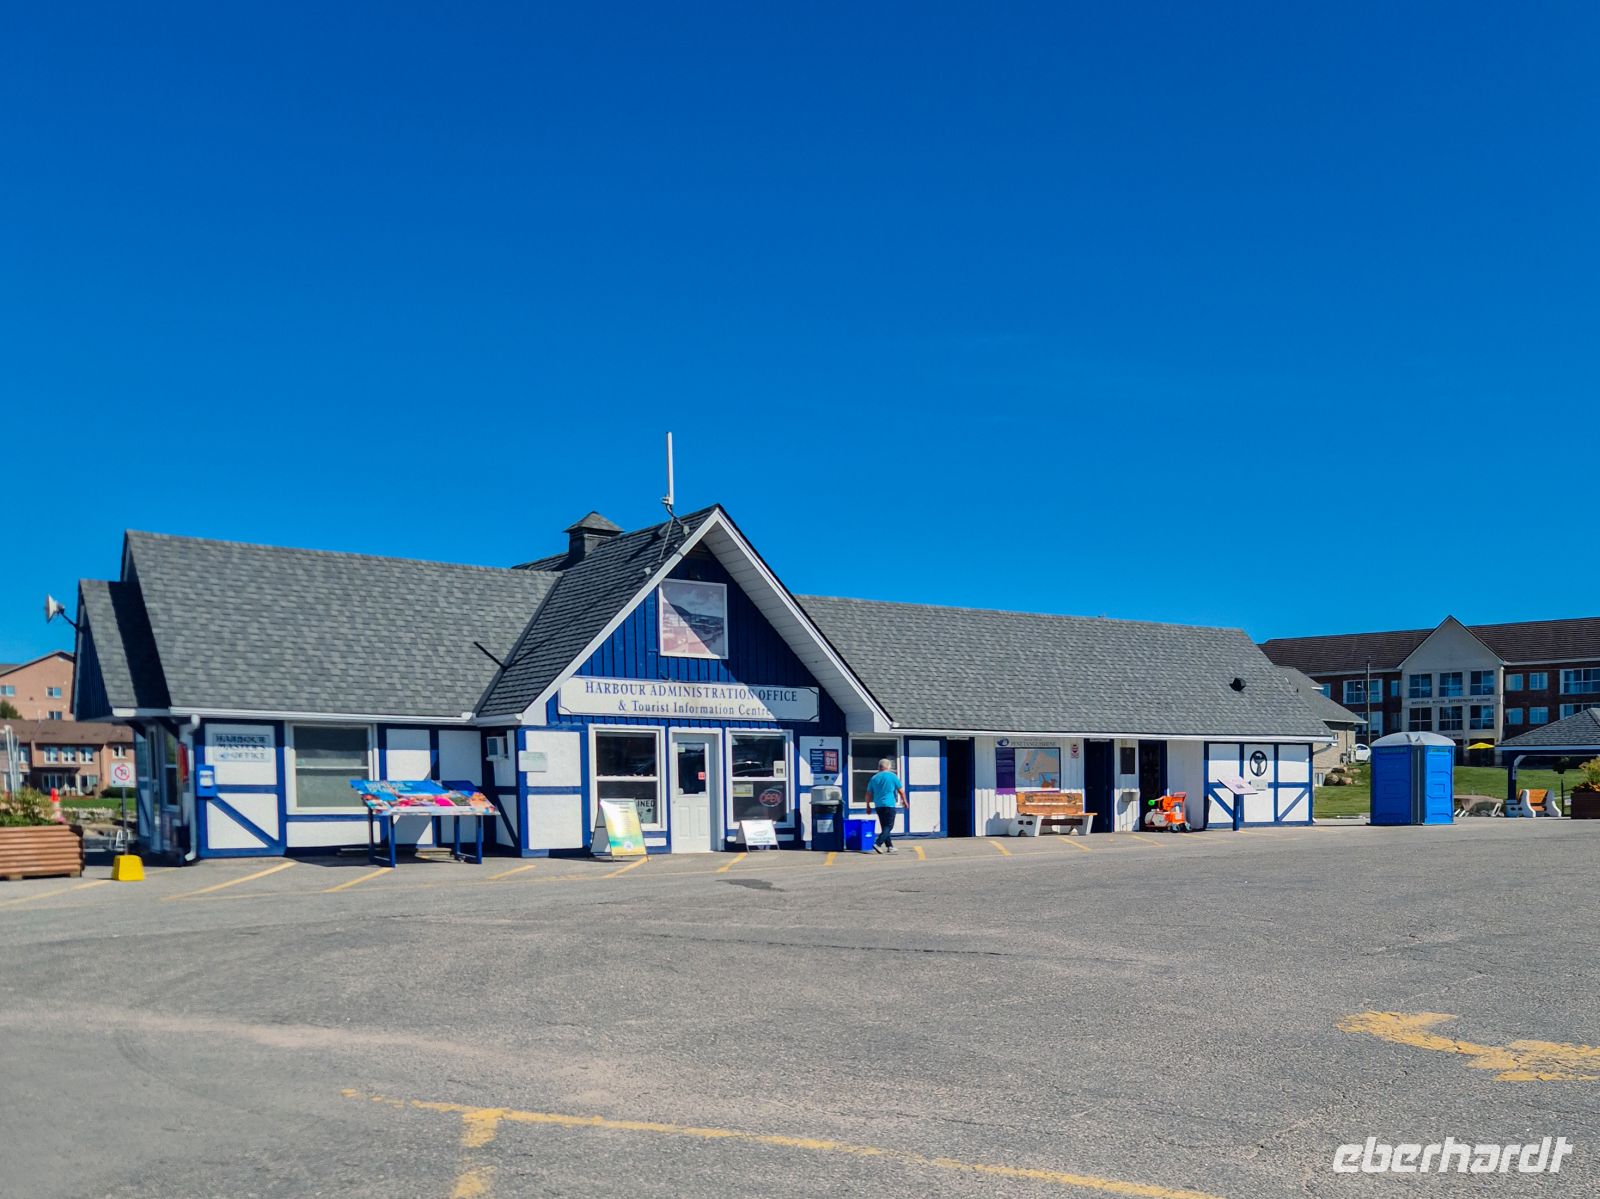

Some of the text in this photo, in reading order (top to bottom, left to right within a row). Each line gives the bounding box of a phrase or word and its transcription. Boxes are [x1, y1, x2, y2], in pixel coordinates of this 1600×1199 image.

[585, 681, 797, 702] HARBOUR ADMINISTRATION OFFICE
[618, 699, 772, 716] & Tourist Information Centre
[818, 738, 824, 747] 2
[825, 756, 837, 766] 911
